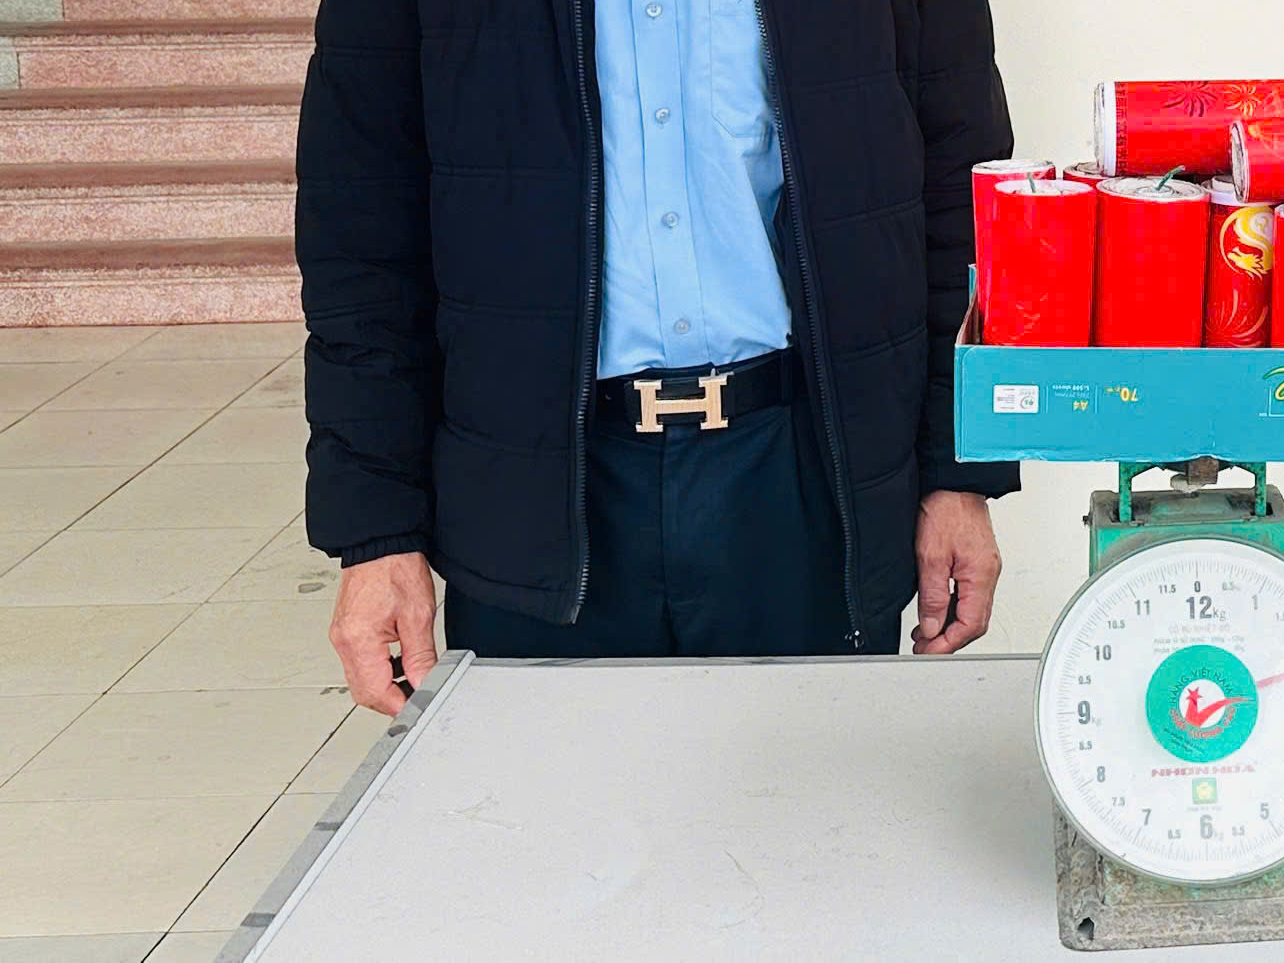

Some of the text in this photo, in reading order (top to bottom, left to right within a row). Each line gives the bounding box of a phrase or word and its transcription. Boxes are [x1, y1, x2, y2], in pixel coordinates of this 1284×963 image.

[1158, 584, 1177, 595] 11.5
[1134, 599, 1151, 616] 11
[1093, 644, 1113, 662] 10
[1096, 765, 1106, 783] 8
[1141, 808, 1152, 826] 7
[1260, 802, 1270, 820] 5
